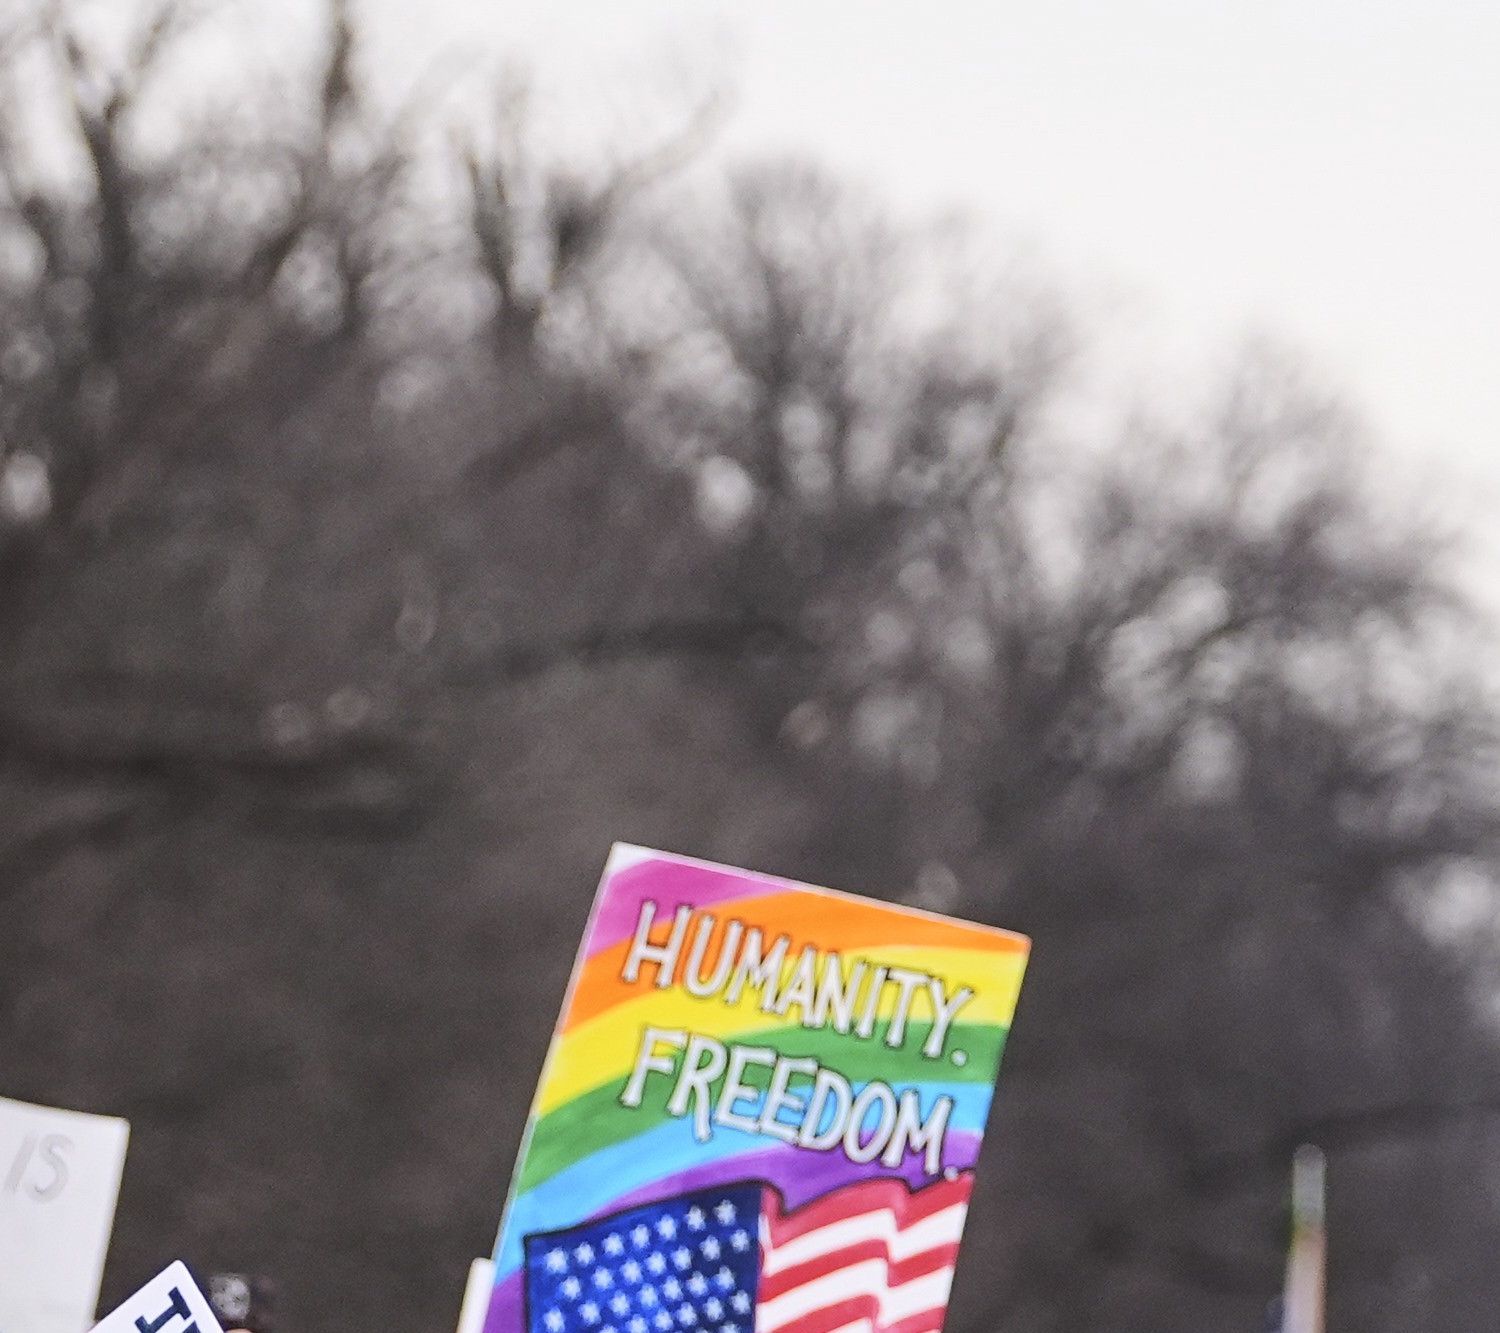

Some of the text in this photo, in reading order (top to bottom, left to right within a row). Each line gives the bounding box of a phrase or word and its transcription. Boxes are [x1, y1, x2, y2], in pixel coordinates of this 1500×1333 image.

[621, 899, 975, 1067] HUMANITY.
[3, 1132, 75, 1203] IS
[620, 1026, 959, 1182] FREEDOM.
